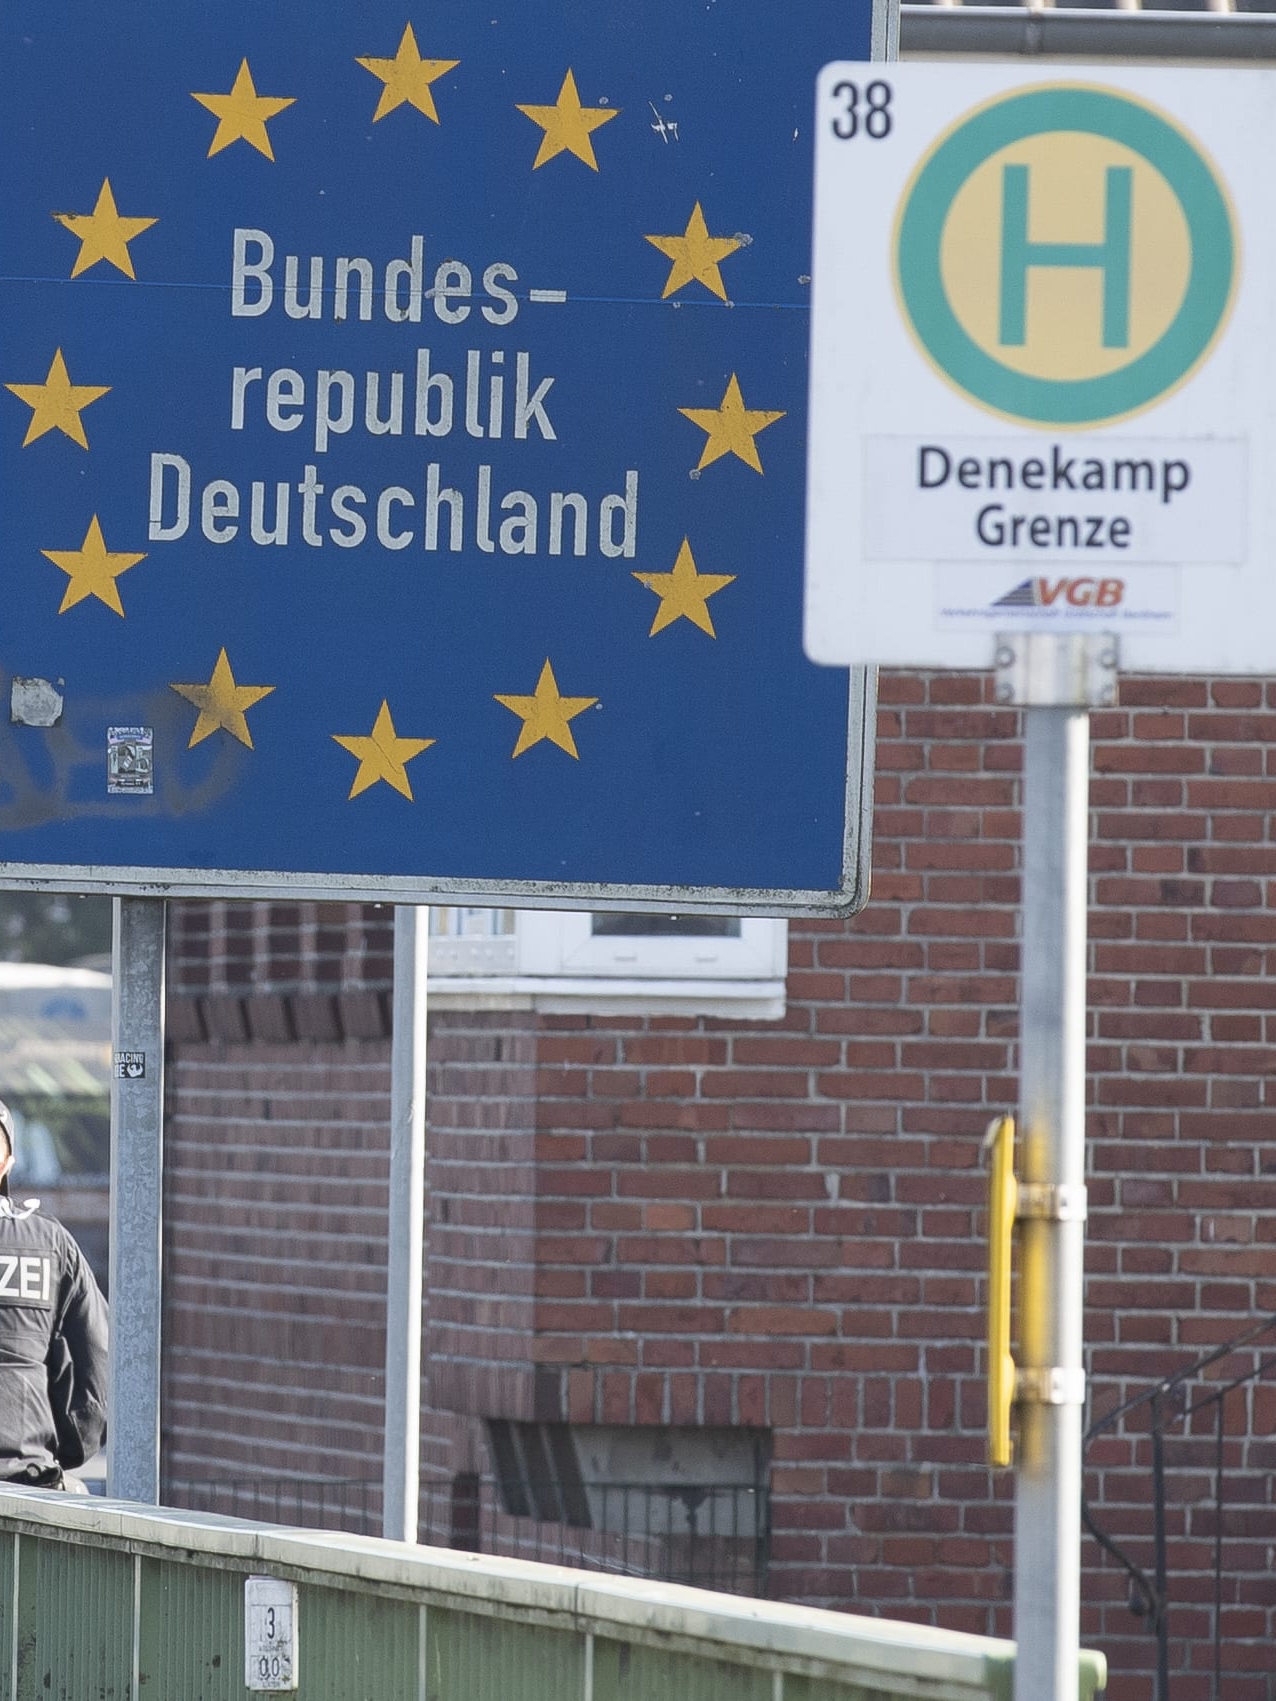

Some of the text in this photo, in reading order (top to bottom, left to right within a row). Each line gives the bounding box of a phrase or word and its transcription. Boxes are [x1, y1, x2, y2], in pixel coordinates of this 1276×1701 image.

[831, 79, 893, 140] 38
[231, 228, 567, 326] Bundes-
[997, 163, 1134, 350] H
[231, 348, 557, 453] republik
[917, 445, 1191, 503] Denekamp
[148, 452, 639, 559] Deutschland
[976, 505, 1132, 548] Grenze
[1038, 576, 1126, 607] VGB
[267, 1607, 276, 1640] 3
